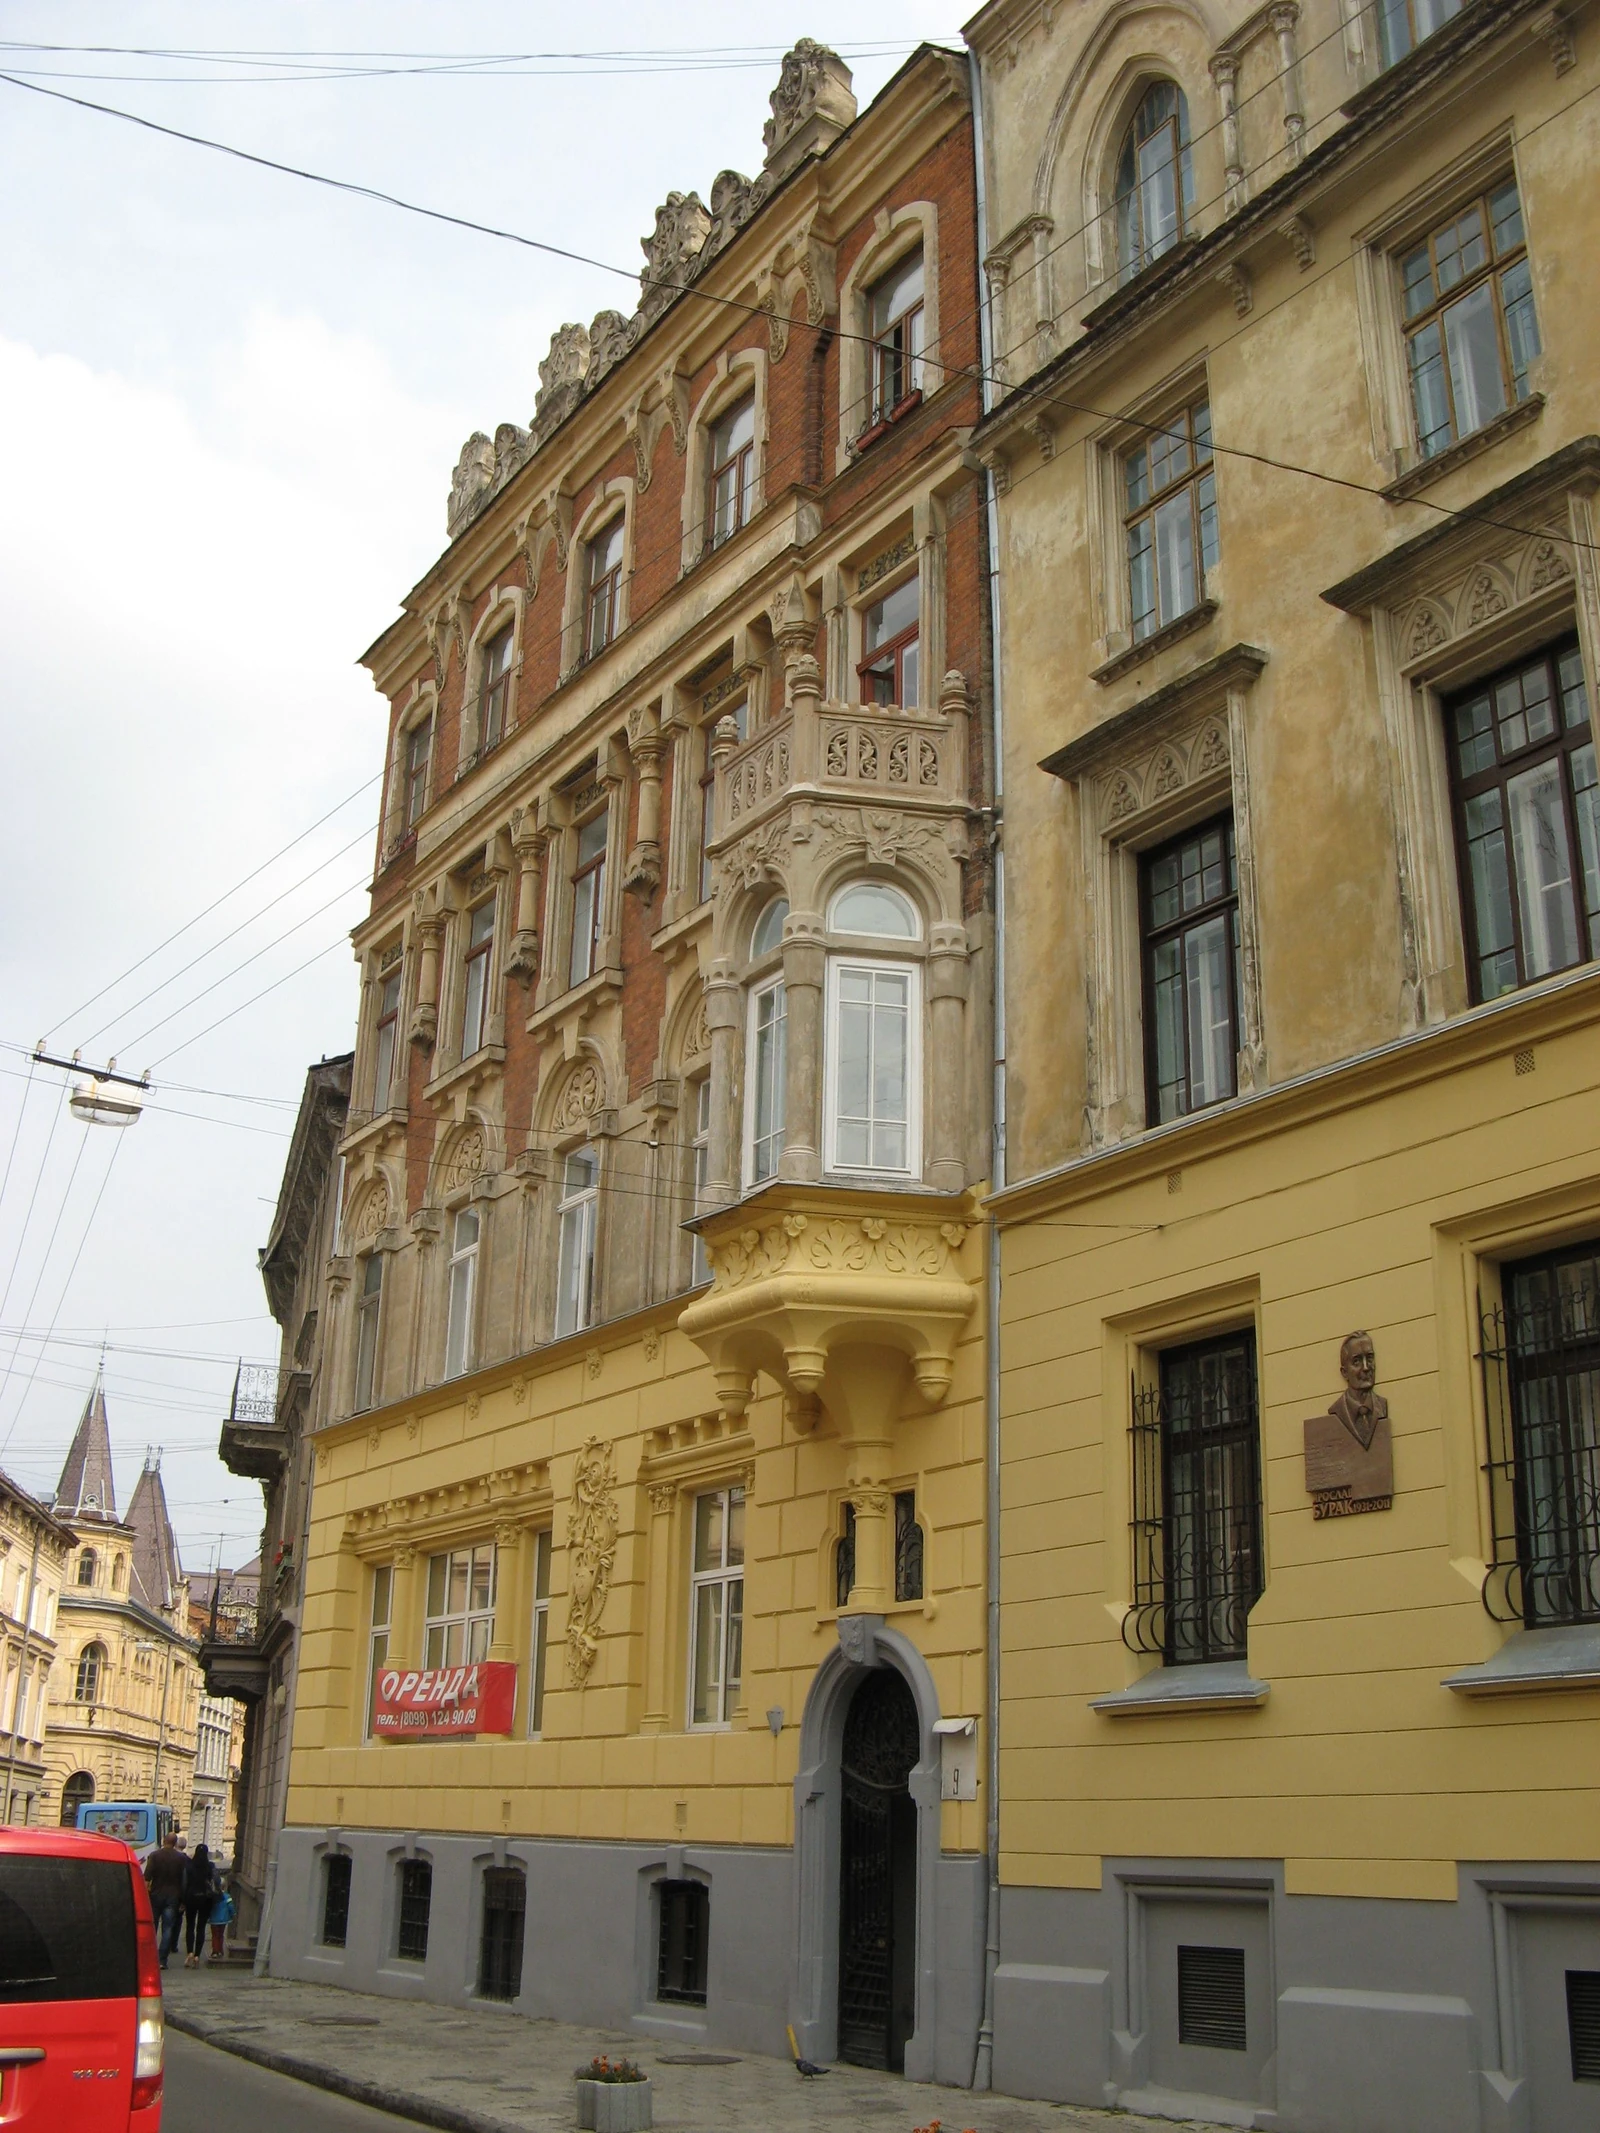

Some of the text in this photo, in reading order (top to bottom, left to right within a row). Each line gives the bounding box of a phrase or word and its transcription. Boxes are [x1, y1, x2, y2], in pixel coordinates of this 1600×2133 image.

[1313, 1498, 1390, 1519] БУРАК 1931-2011
[381, 1665, 479, 1708] ОРЕНДА
[376, 1708, 477, 1729] тел.: (8098) 124 90 09
[953, 1768, 960, 1795] 9
